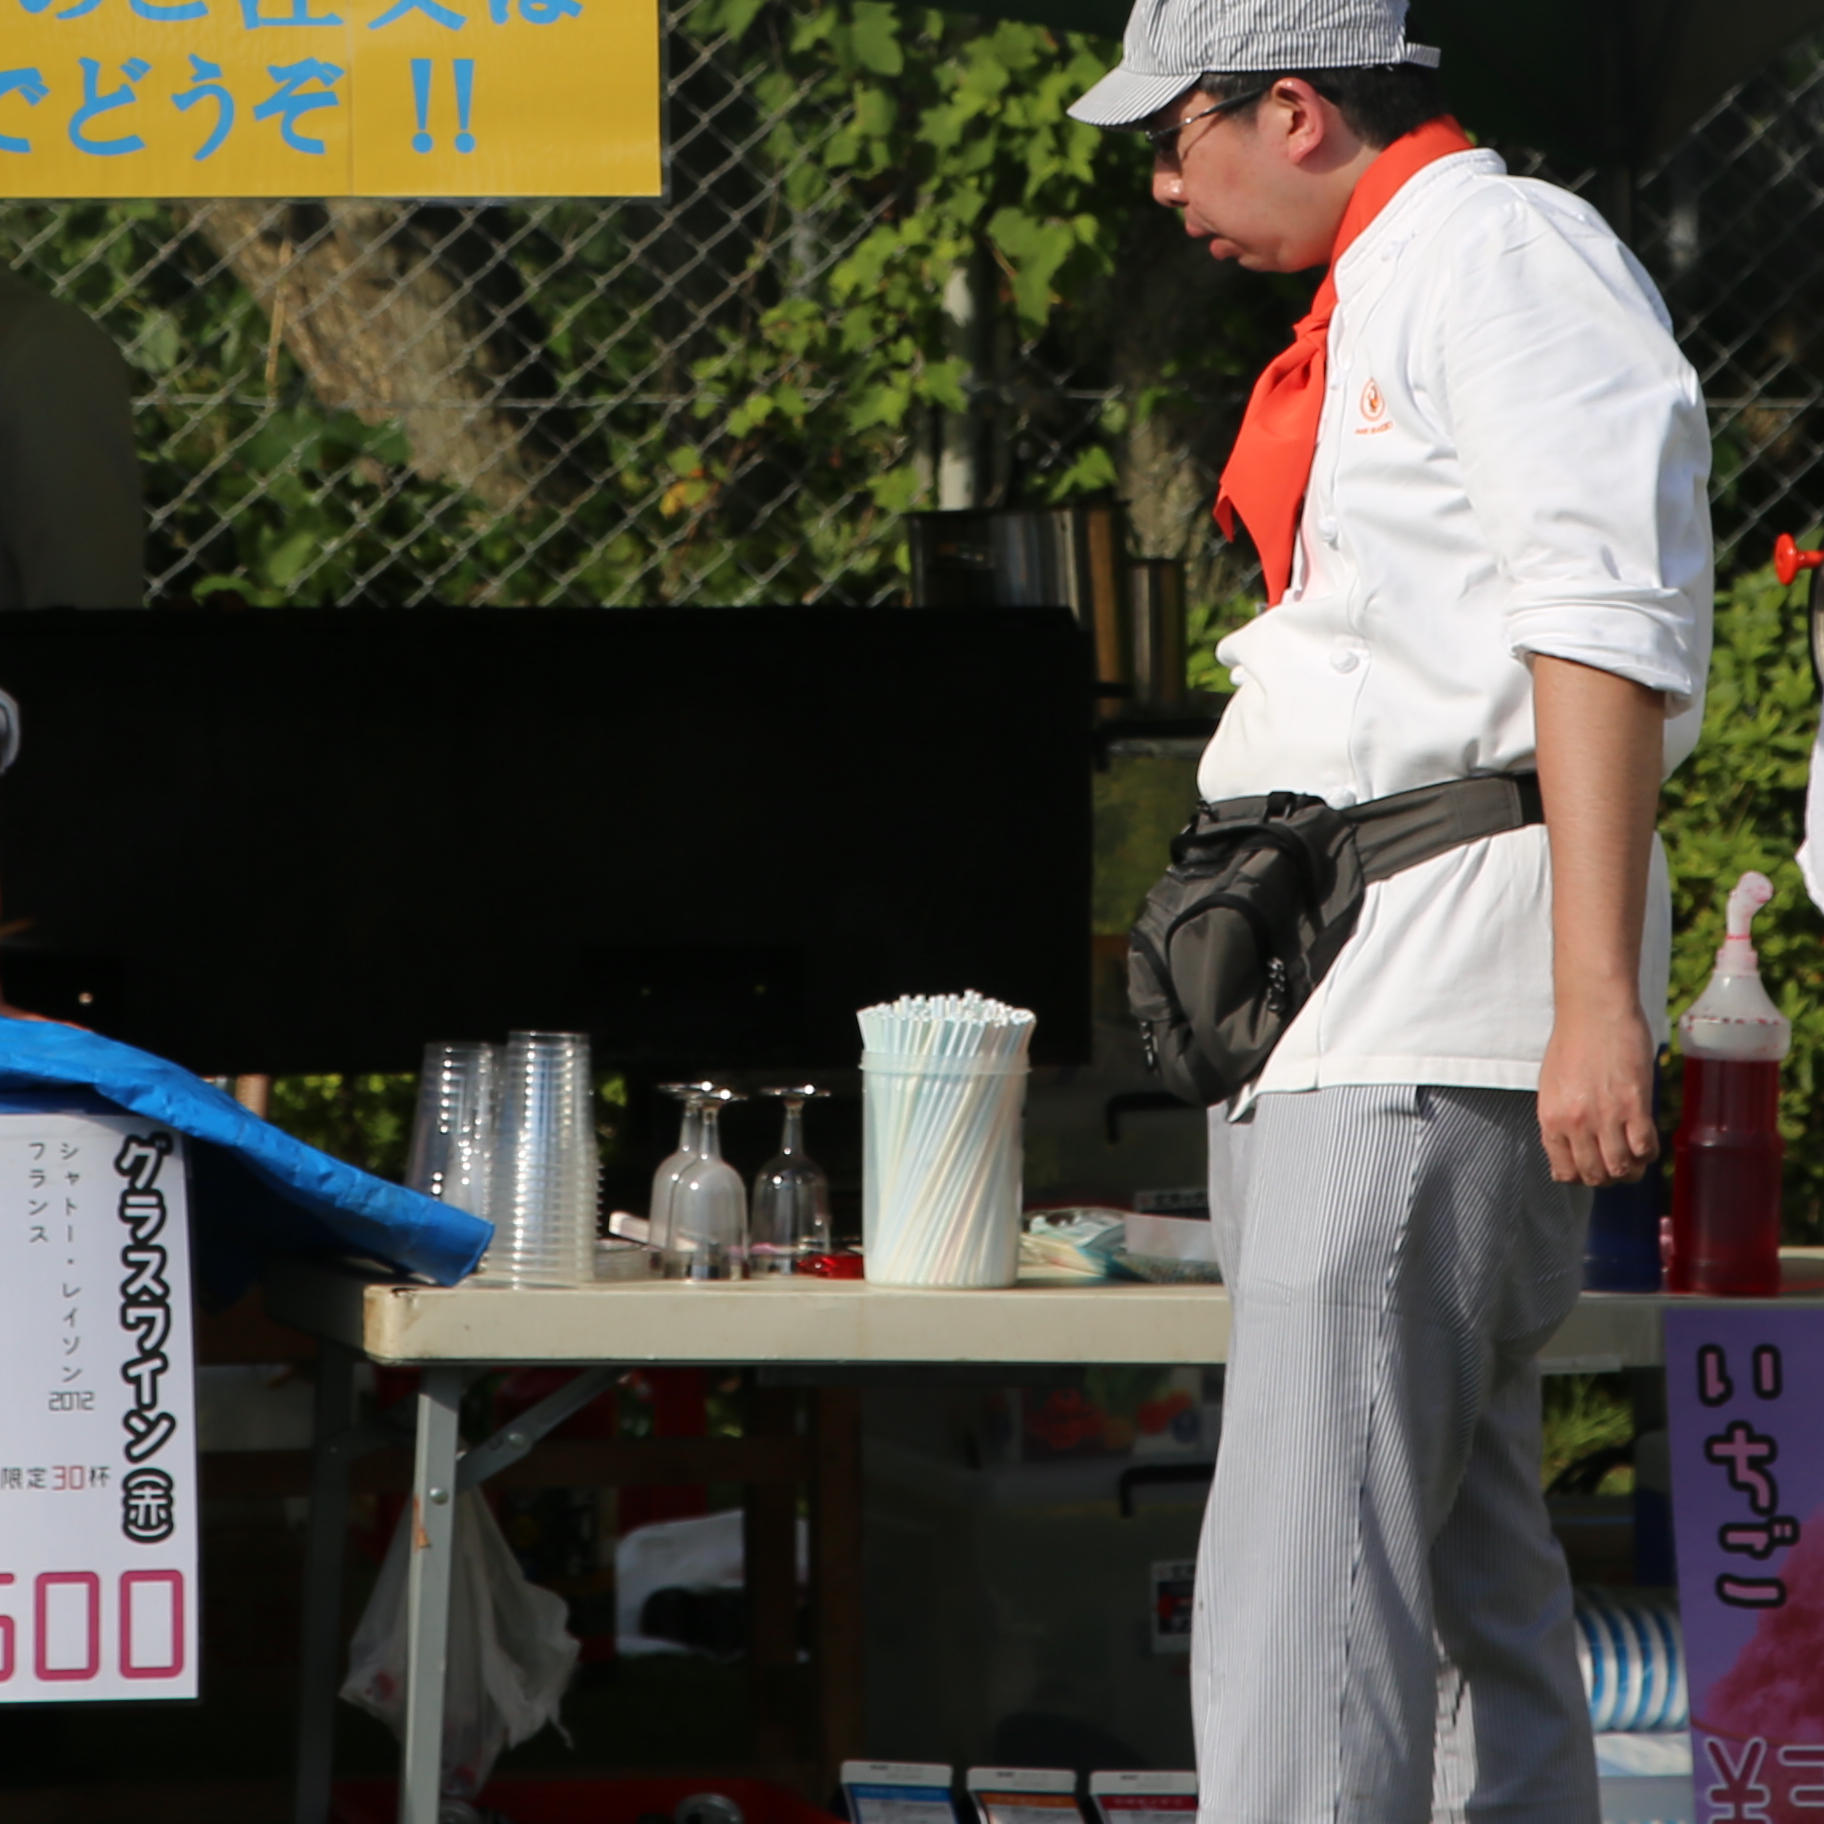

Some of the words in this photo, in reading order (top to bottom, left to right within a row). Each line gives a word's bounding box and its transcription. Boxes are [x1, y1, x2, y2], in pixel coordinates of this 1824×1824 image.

[28, 1142, 49, 1243] フランス
[48, 1391, 96, 1412] 2012
[0, 1465, 111, 1492] 限定30杯
[1695, 1343, 1801, 1610] いちご
